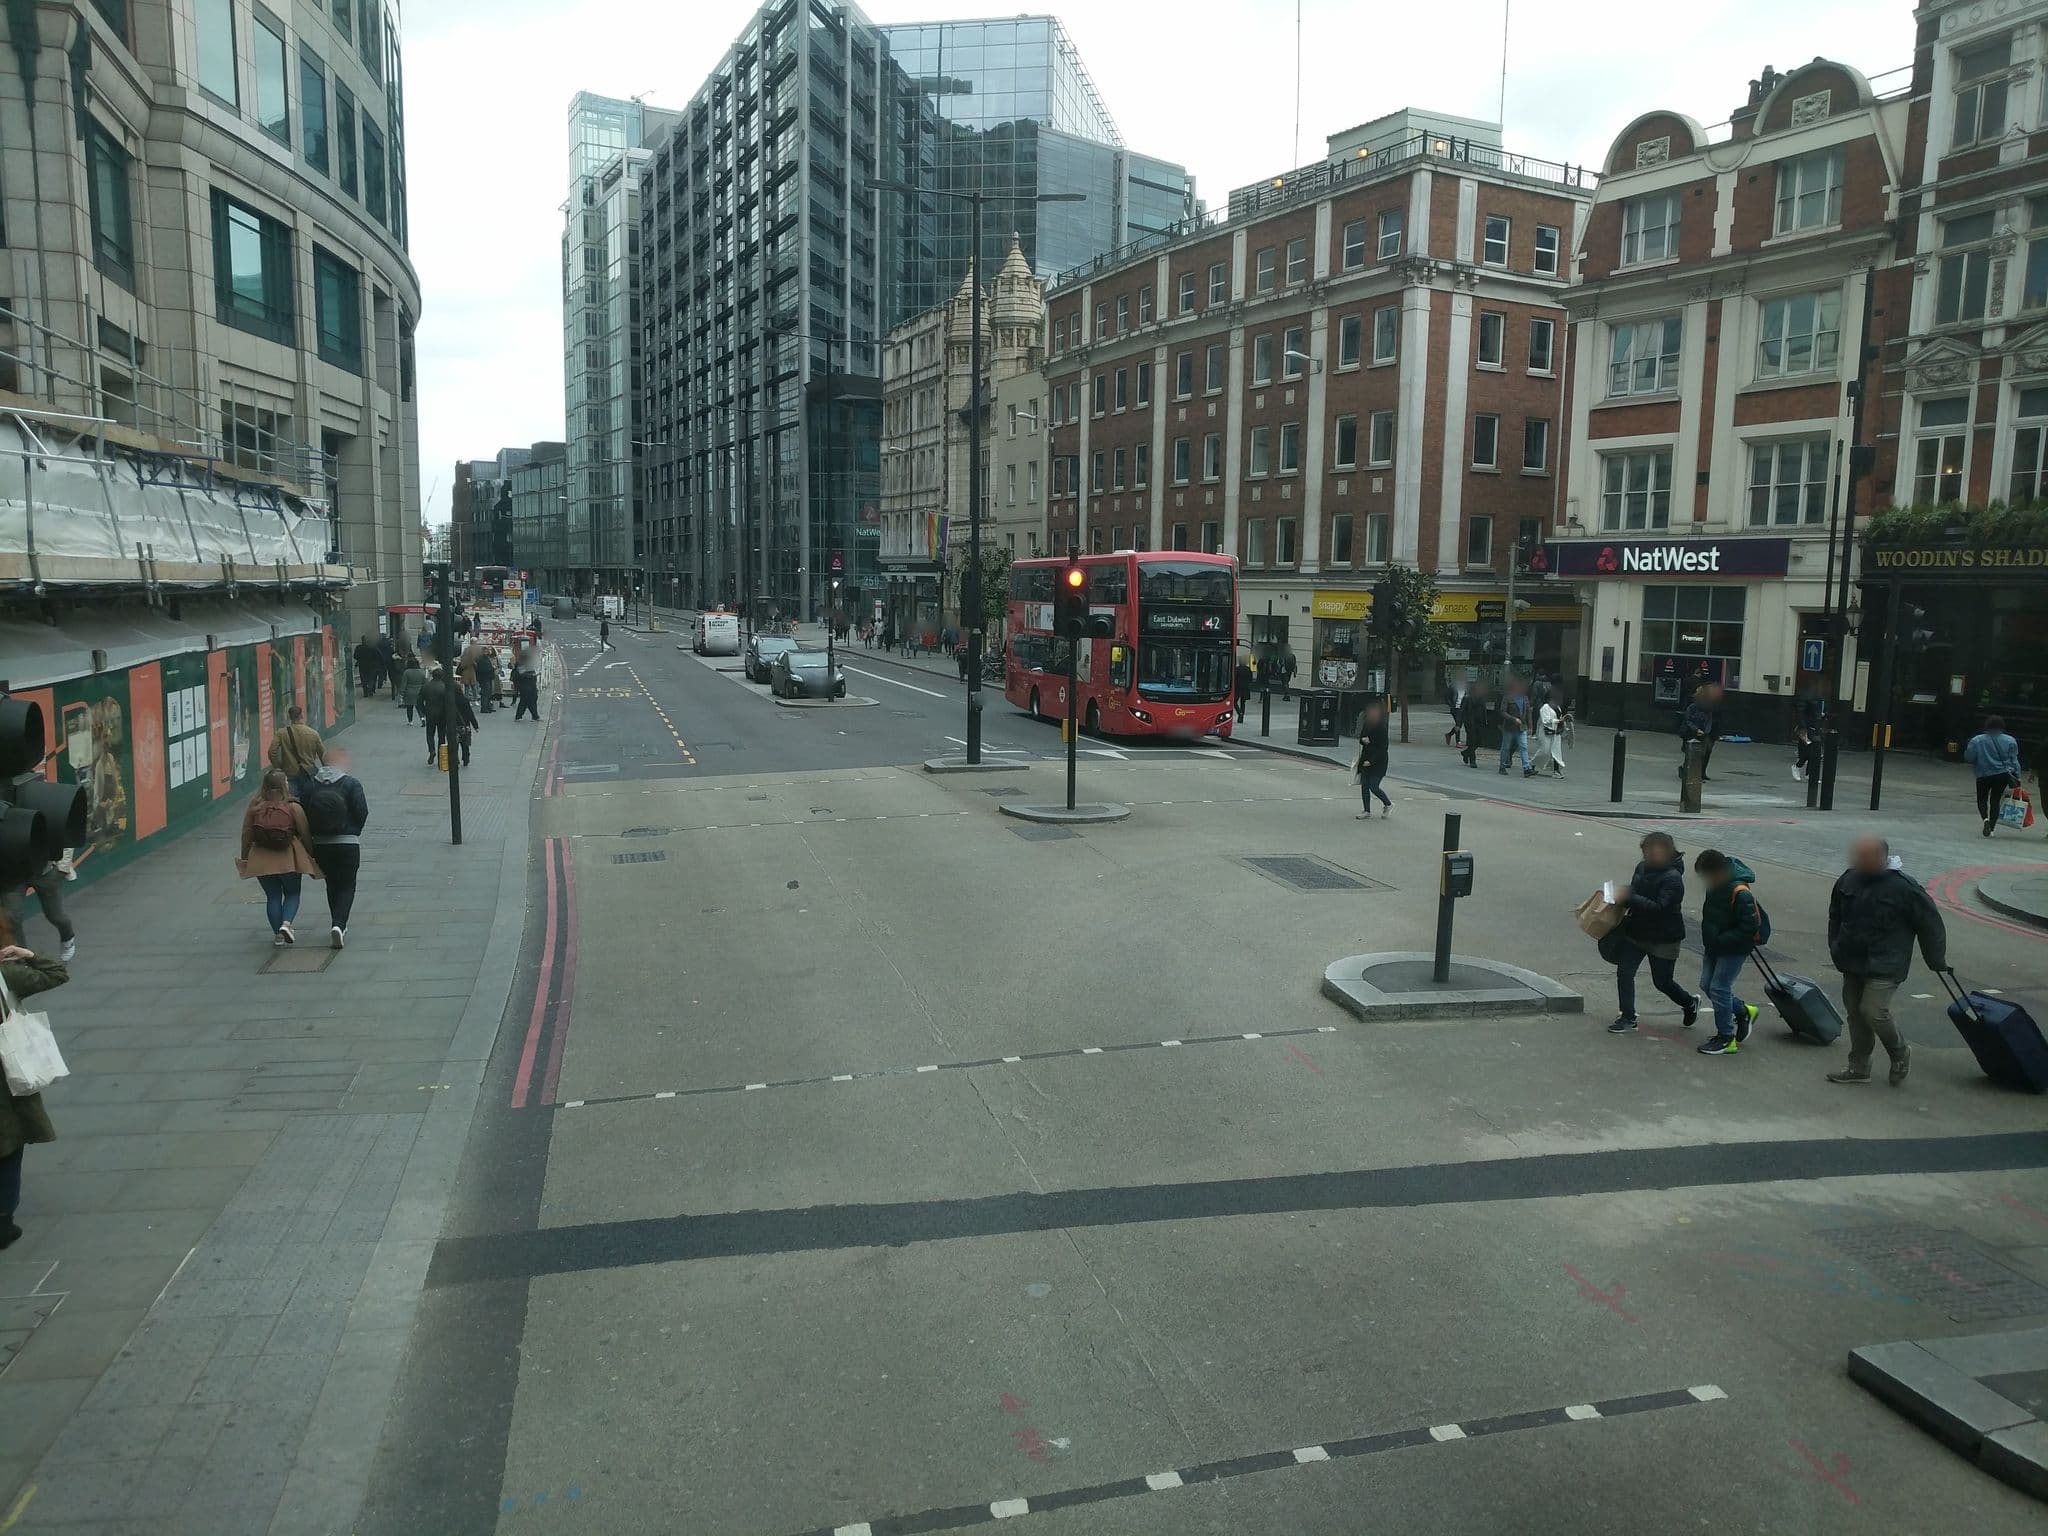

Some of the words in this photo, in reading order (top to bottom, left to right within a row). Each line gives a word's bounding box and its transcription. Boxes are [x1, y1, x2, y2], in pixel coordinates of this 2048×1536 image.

[1623, 546, 1720, 571] NatWest
[1876, 549, 1975, 567] WOODIN'S
[1153, 614, 1166, 623] East
[1167, 615, 1191, 623] Dulwich
[1206, 616, 1220, 630] 42
[1682, 634, 1705, 642] Premier
